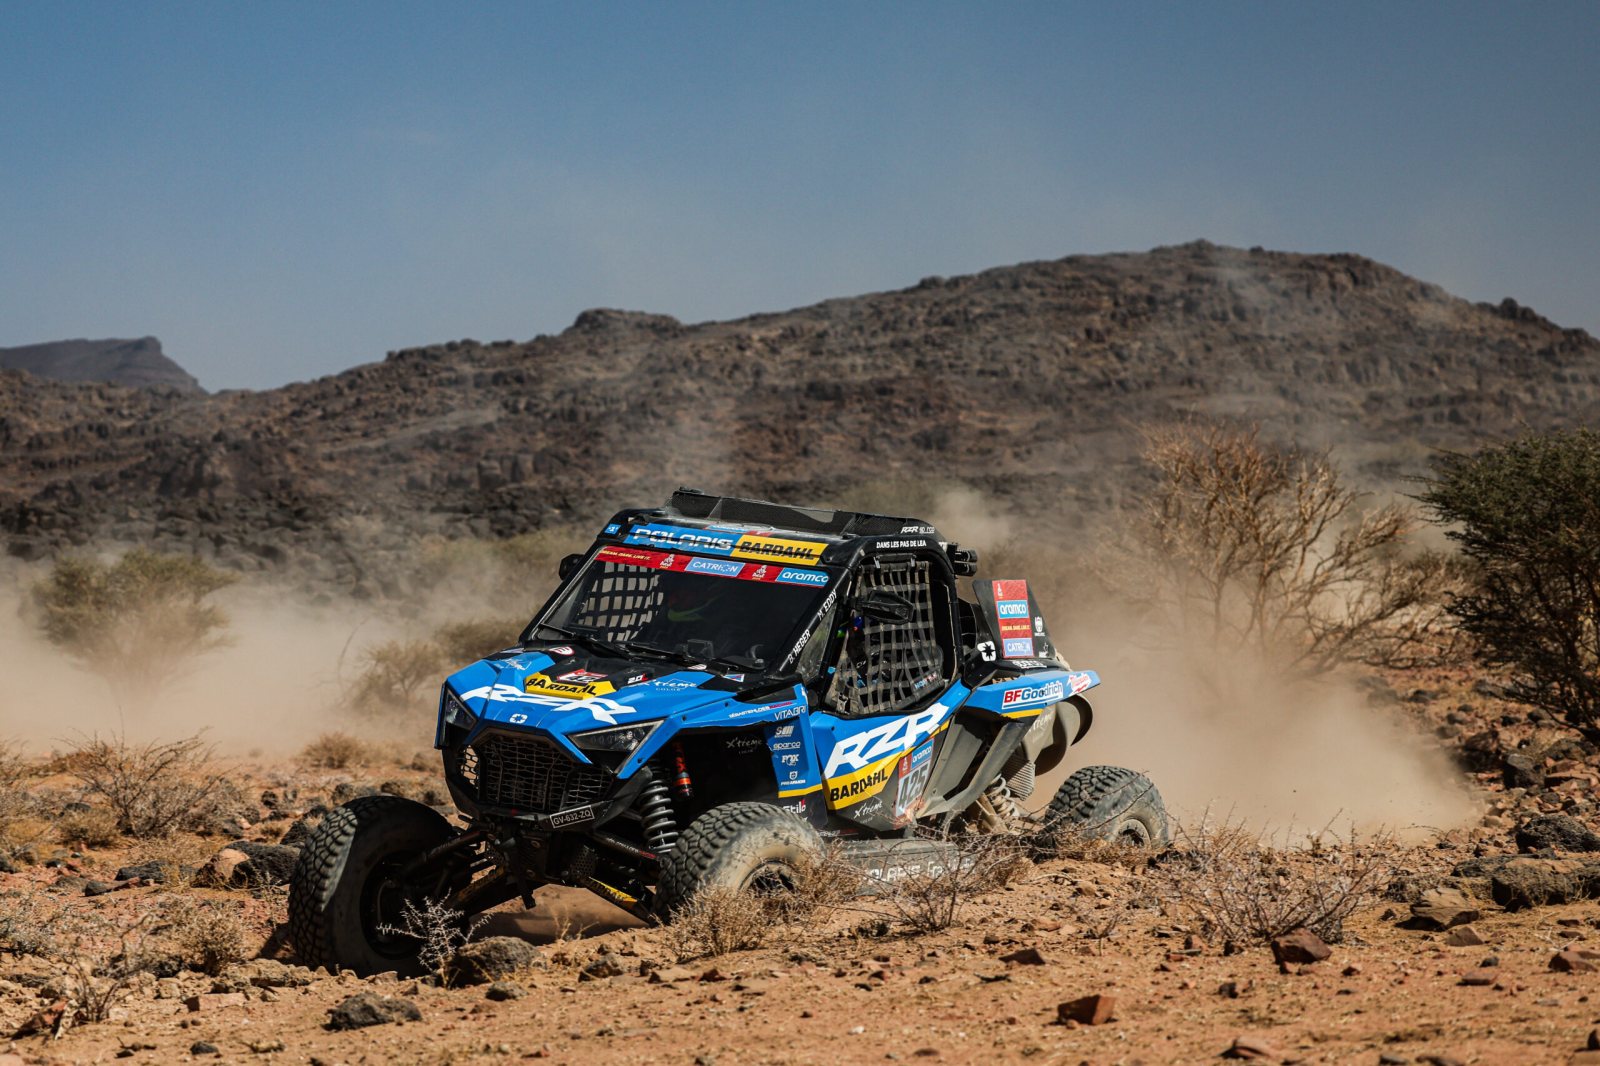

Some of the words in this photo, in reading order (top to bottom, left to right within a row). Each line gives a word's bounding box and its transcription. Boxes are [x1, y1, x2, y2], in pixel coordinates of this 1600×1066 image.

[901, 526, 919, 534] RZR
[633, 528, 733, 551] POLARIS
[876, 541, 890, 549] DANS
[739, 541, 814, 560] BARDAHL
[782, 571, 829, 583] aramco
[817, 609, 826, 620] M.
[823, 588, 837, 612] EDDY
[1000, 604, 1027, 614] aramco
[793, 629, 811, 657] HEGER
[526, 678, 597, 696] BARDAHL
[1003, 680, 1063, 703] BFGoodrich
[774, 705, 807, 720] VITABRI
[773, 741, 801, 750] sparco
[824, 702, 950, 779] RZR
[913, 746, 932, 763] aramco
[830, 767, 888, 802] BARDAHL
[899, 763, 930, 812] 425
[553, 809, 592, 825] GV-632-ZQ
